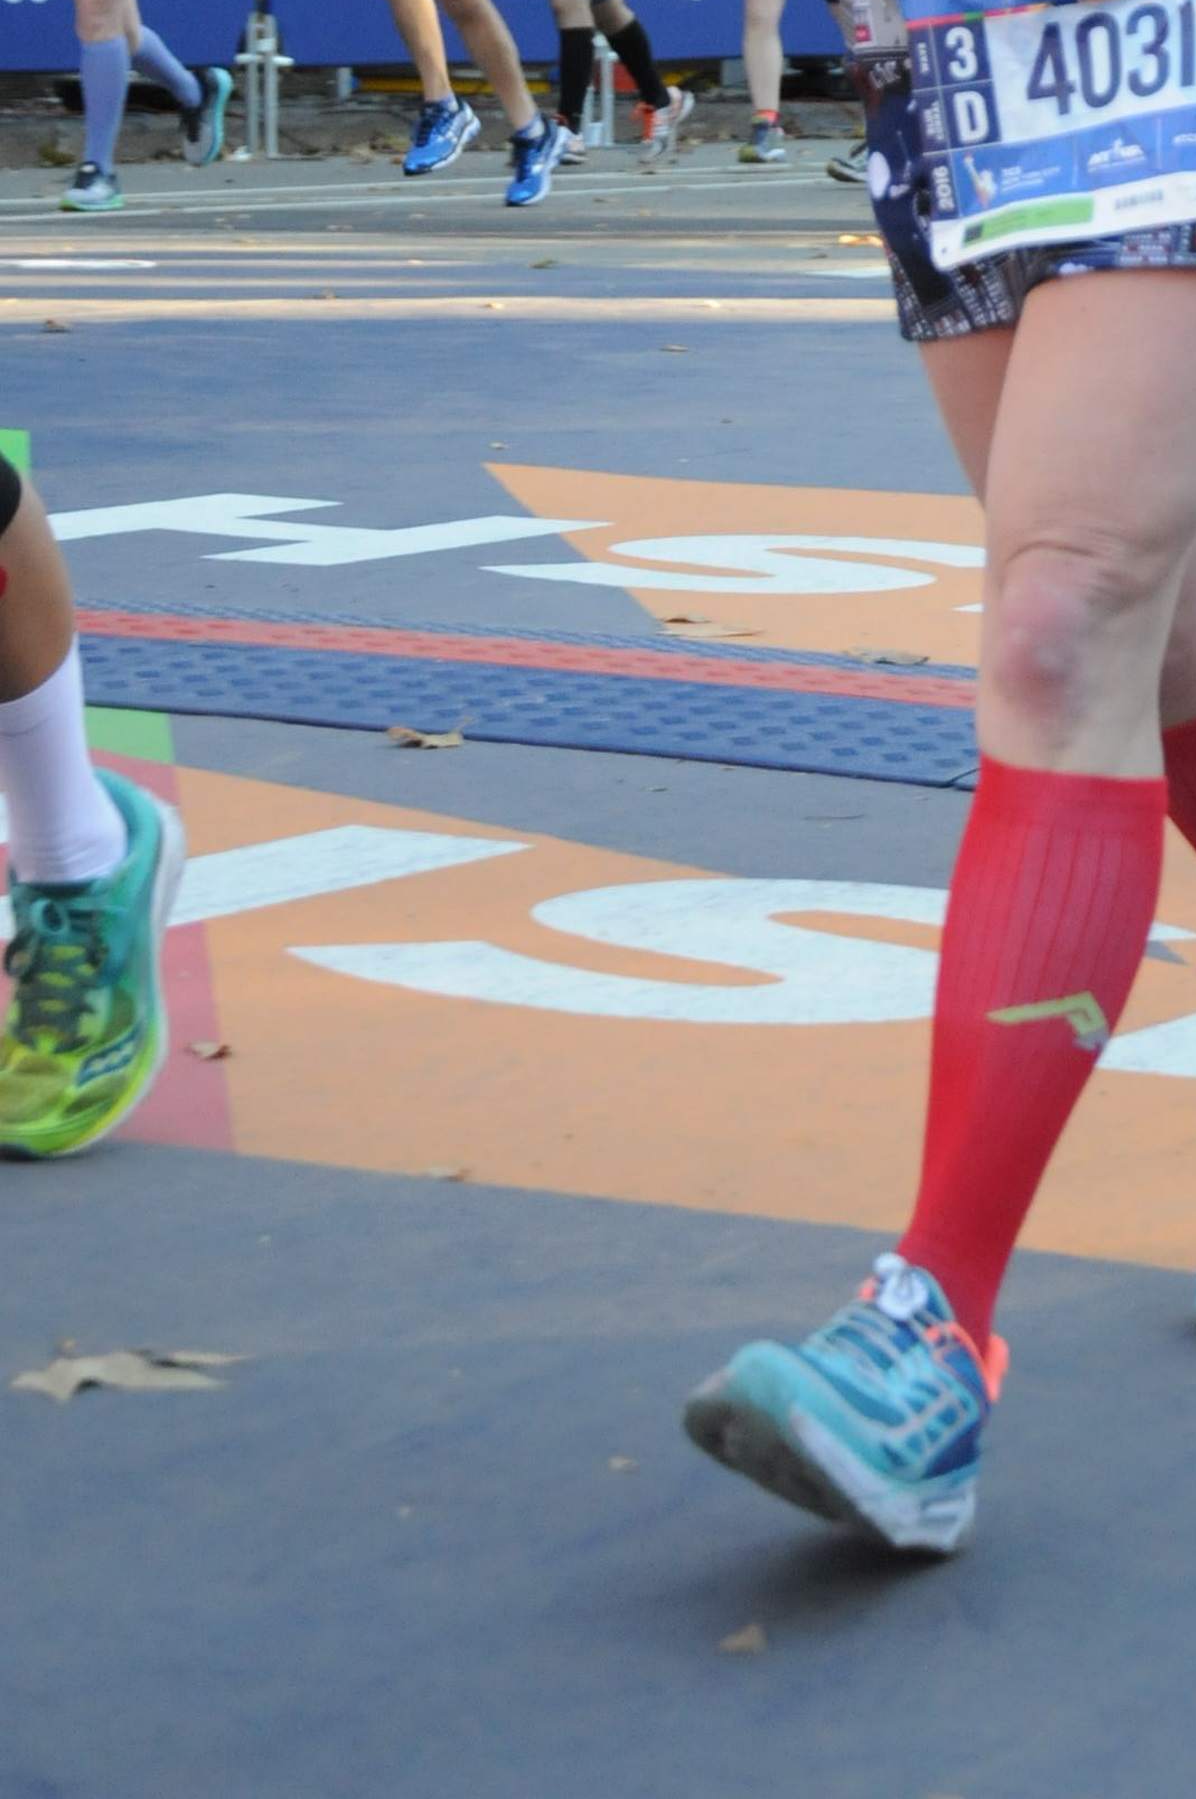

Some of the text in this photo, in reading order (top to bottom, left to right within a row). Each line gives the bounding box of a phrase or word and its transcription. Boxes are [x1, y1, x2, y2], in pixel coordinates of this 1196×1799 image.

[945, 25, 979, 80] 3
[953, 90, 990, 145] D
[932, 166, 955, 211] 2016
